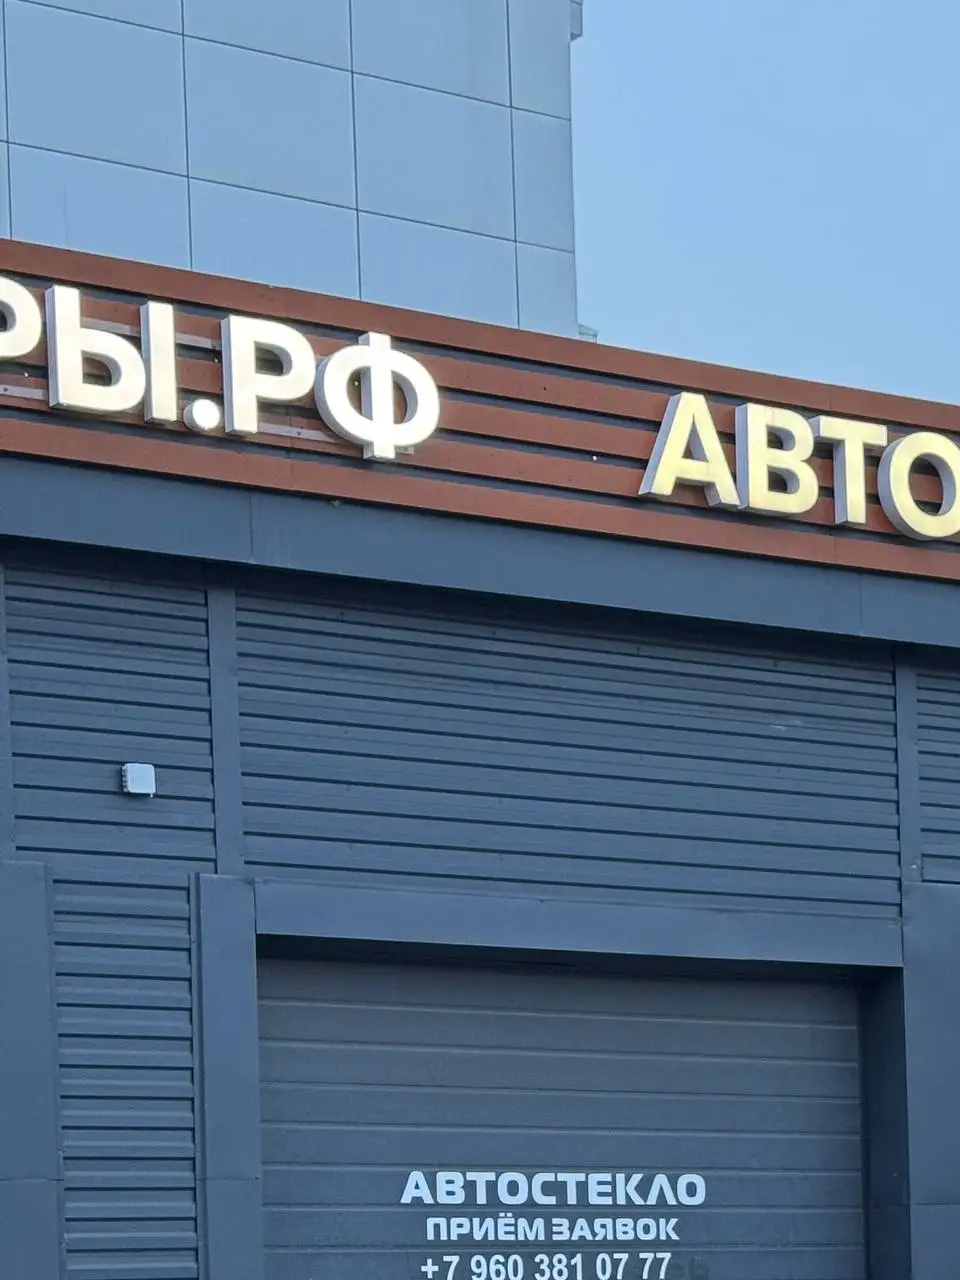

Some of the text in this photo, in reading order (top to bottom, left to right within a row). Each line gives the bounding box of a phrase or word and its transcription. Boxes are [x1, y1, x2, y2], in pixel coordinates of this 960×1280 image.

[400, 1170, 706, 1206] АВТОСТЕКЛО
[426, 1213, 680, 1241] ПРИЁМ ЗАЯВОК
[534, 1253, 584, 1280] 381
[595, 1253, 630, 1280] 07
[639, 1252, 672, 1280] 77
